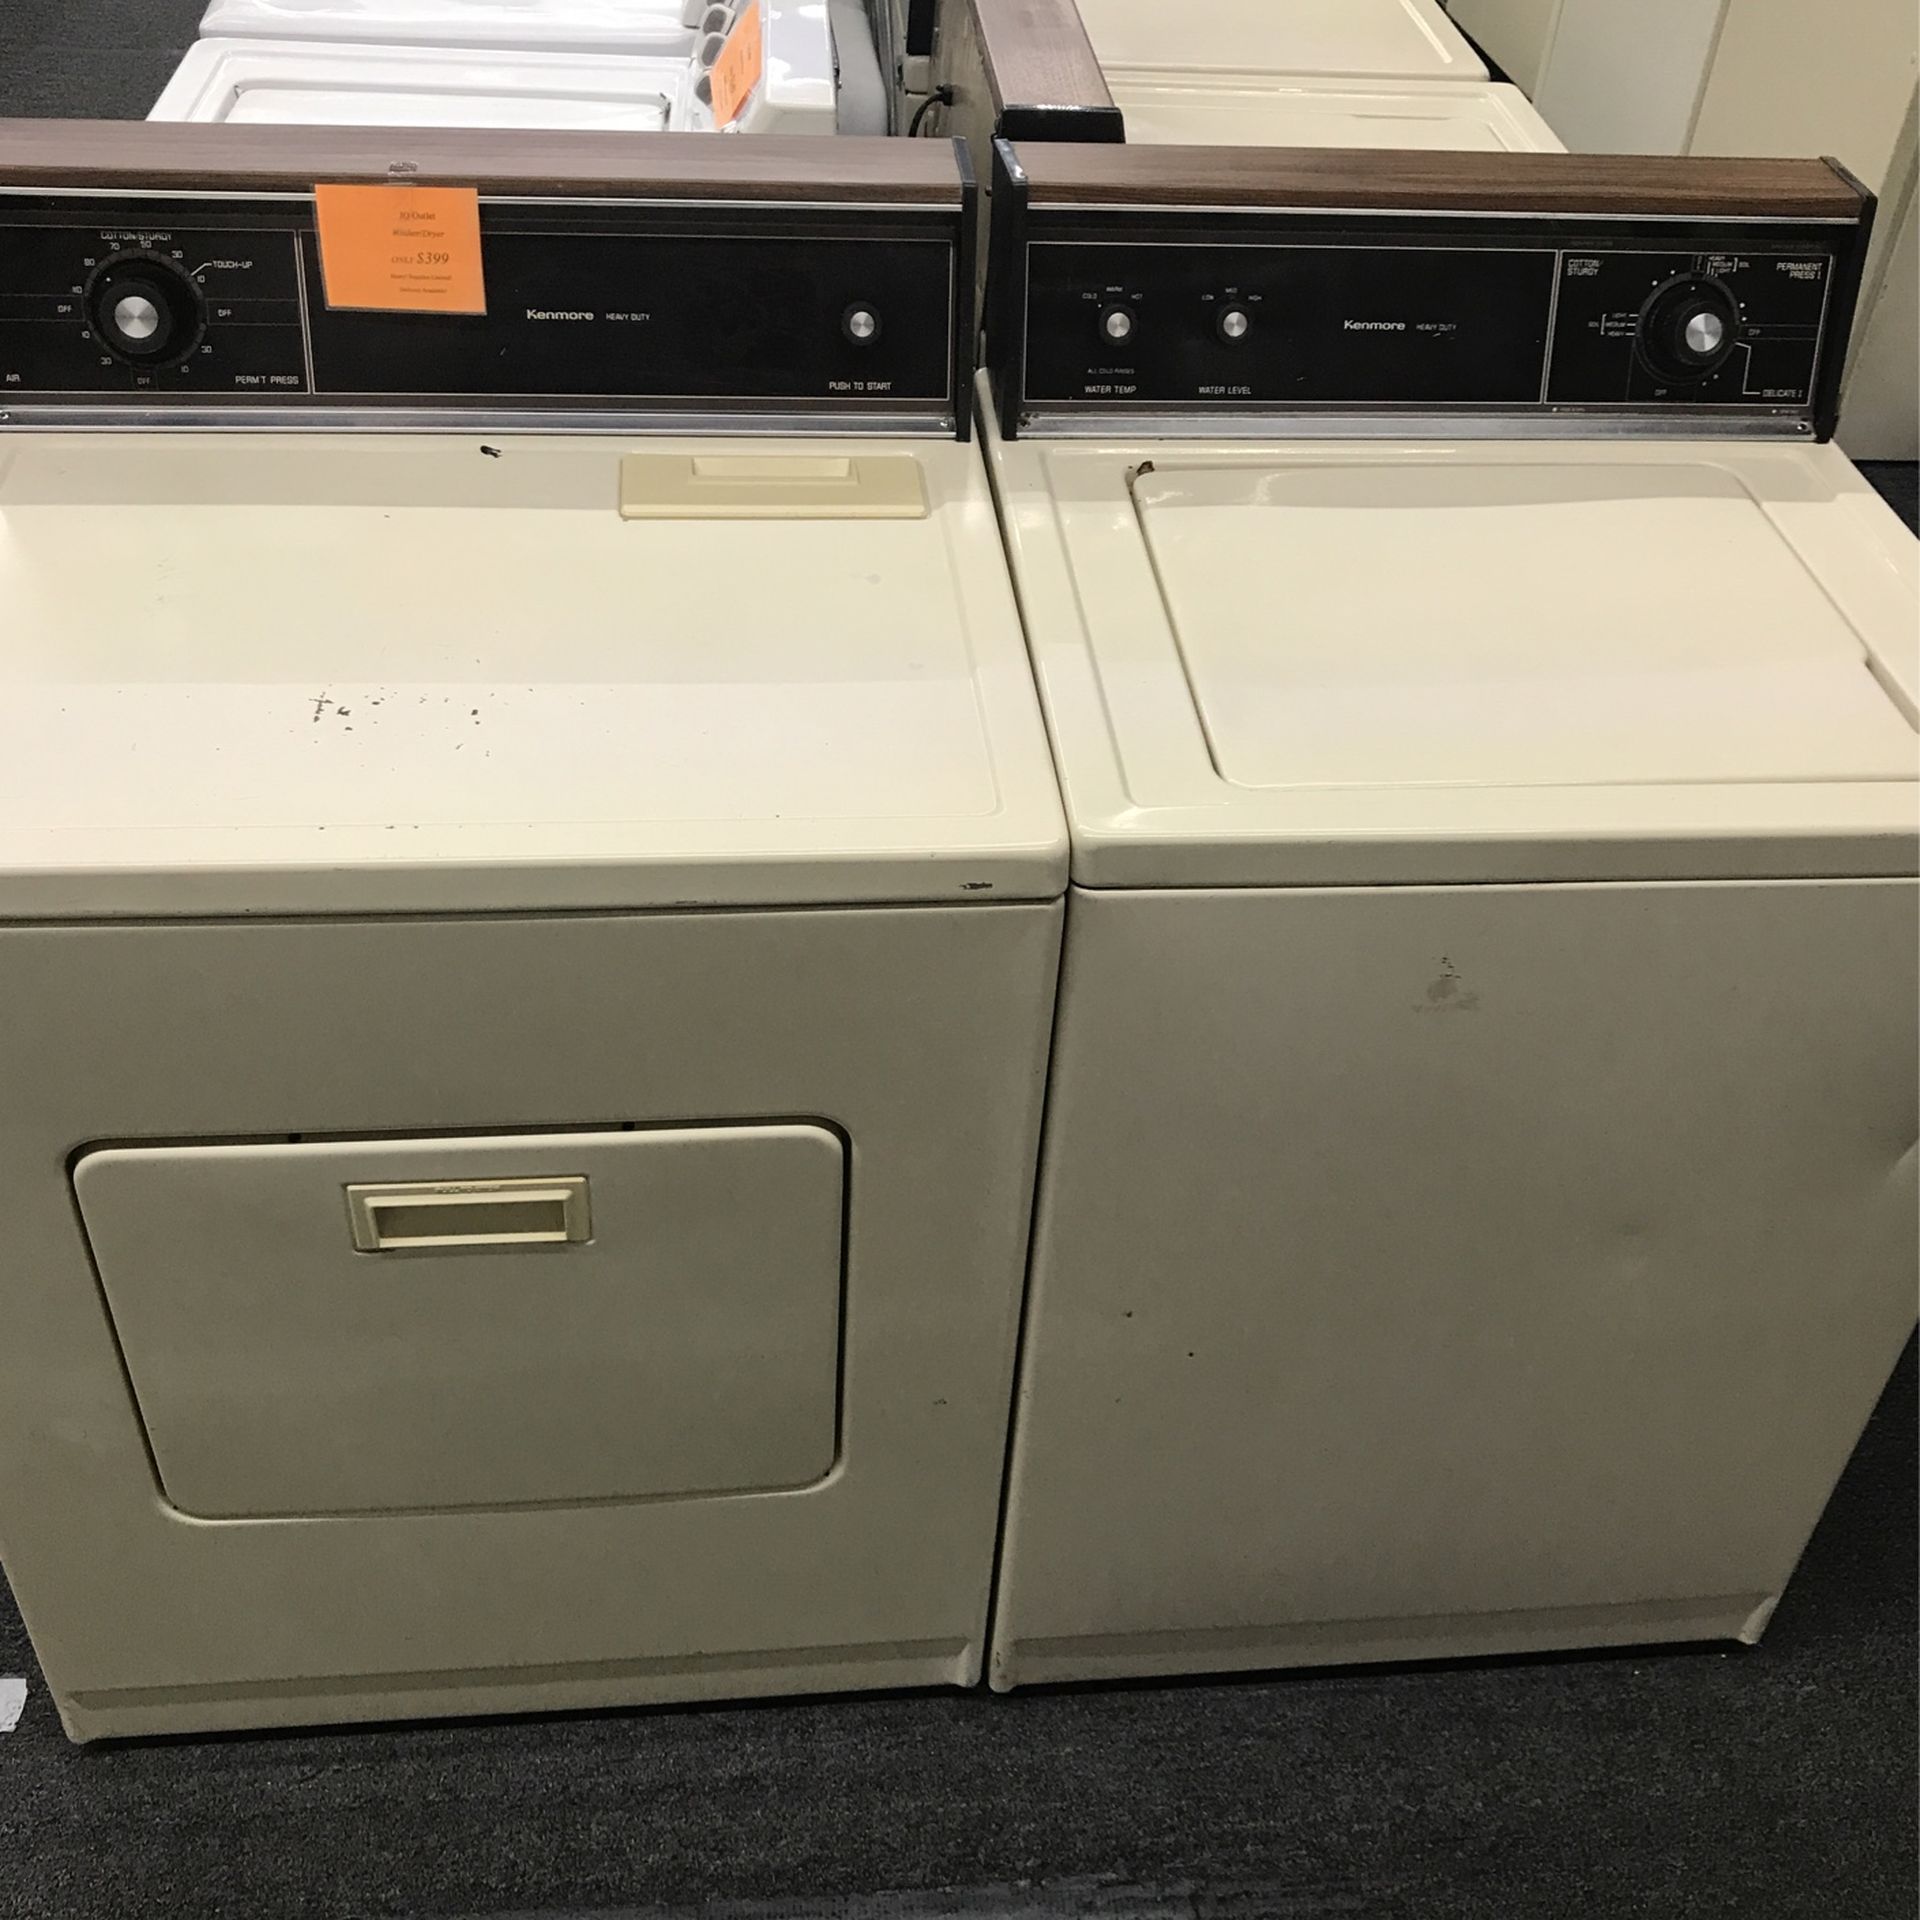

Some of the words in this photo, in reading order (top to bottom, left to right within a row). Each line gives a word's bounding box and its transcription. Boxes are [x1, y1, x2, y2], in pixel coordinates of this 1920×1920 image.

[171, 250, 183, 258] 30
[416, 252, 449, 264] $399
[212, 260, 253, 269] TOUCH-UP
[1776, 262, 1823, 271] PERMANENT
[1567, 267, 1599, 276] STURDY
[1789, 270, 1816, 280] PRESS
[57, 304, 72, 313] OFF
[217, 309, 232, 317] OFF
[526, 309, 594, 321] Kenmore
[606, 312, 629, 321] HEAVY
[630, 313, 650, 321] DUTY
[1344, 319, 1406, 331] Kenmore
[1416, 323, 1437, 331] HEAVY
[1438, 323, 1457, 331] DUTY
[201, 346, 212, 354] 30
[270, 375, 299, 385] PRESS
[829, 381, 851, 391] PUSH
[853, 381, 864, 391] TO
[867, 381, 892, 391] START
[1085, 385, 1112, 394] WATER
[1114, 385, 1137, 394] TEMP
[1198, 386, 1225, 395] WATER
[1227, 386, 1252, 395] LEVEL
[1762, 388, 1797, 398] DELICATE
